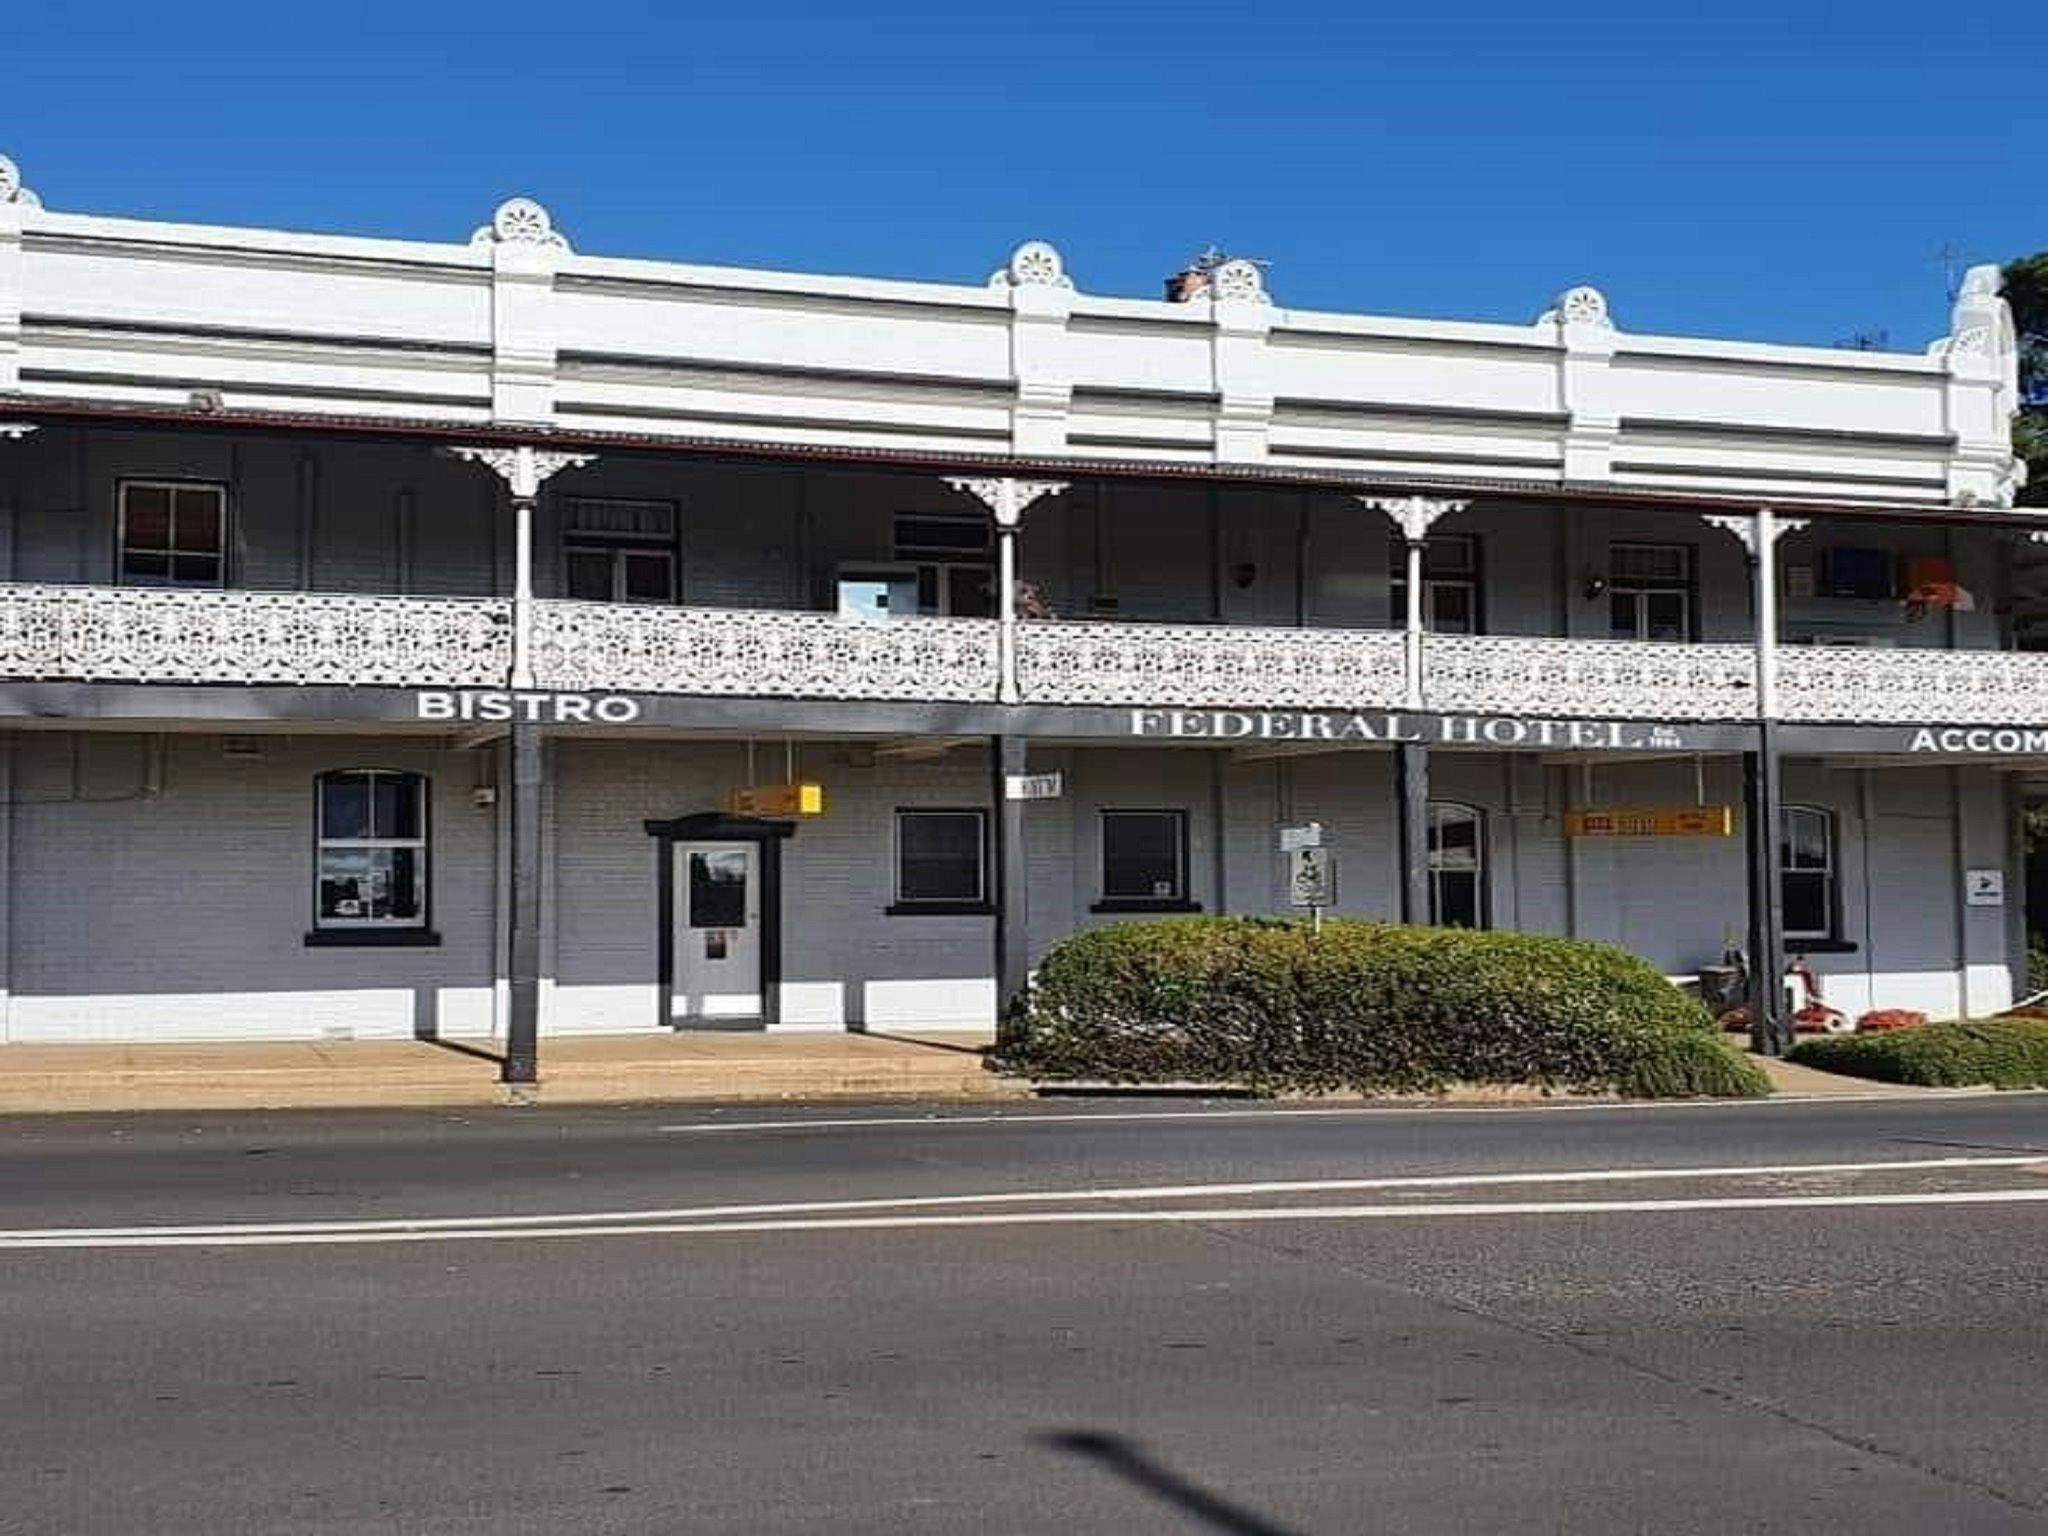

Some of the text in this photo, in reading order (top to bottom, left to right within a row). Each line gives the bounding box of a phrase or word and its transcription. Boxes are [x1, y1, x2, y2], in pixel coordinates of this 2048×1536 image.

[417, 691, 638, 721] BISTRO
[1130, 709, 1643, 747] FEDERAL HOTEL
[1910, 728, 2048, 752] ACCOM
